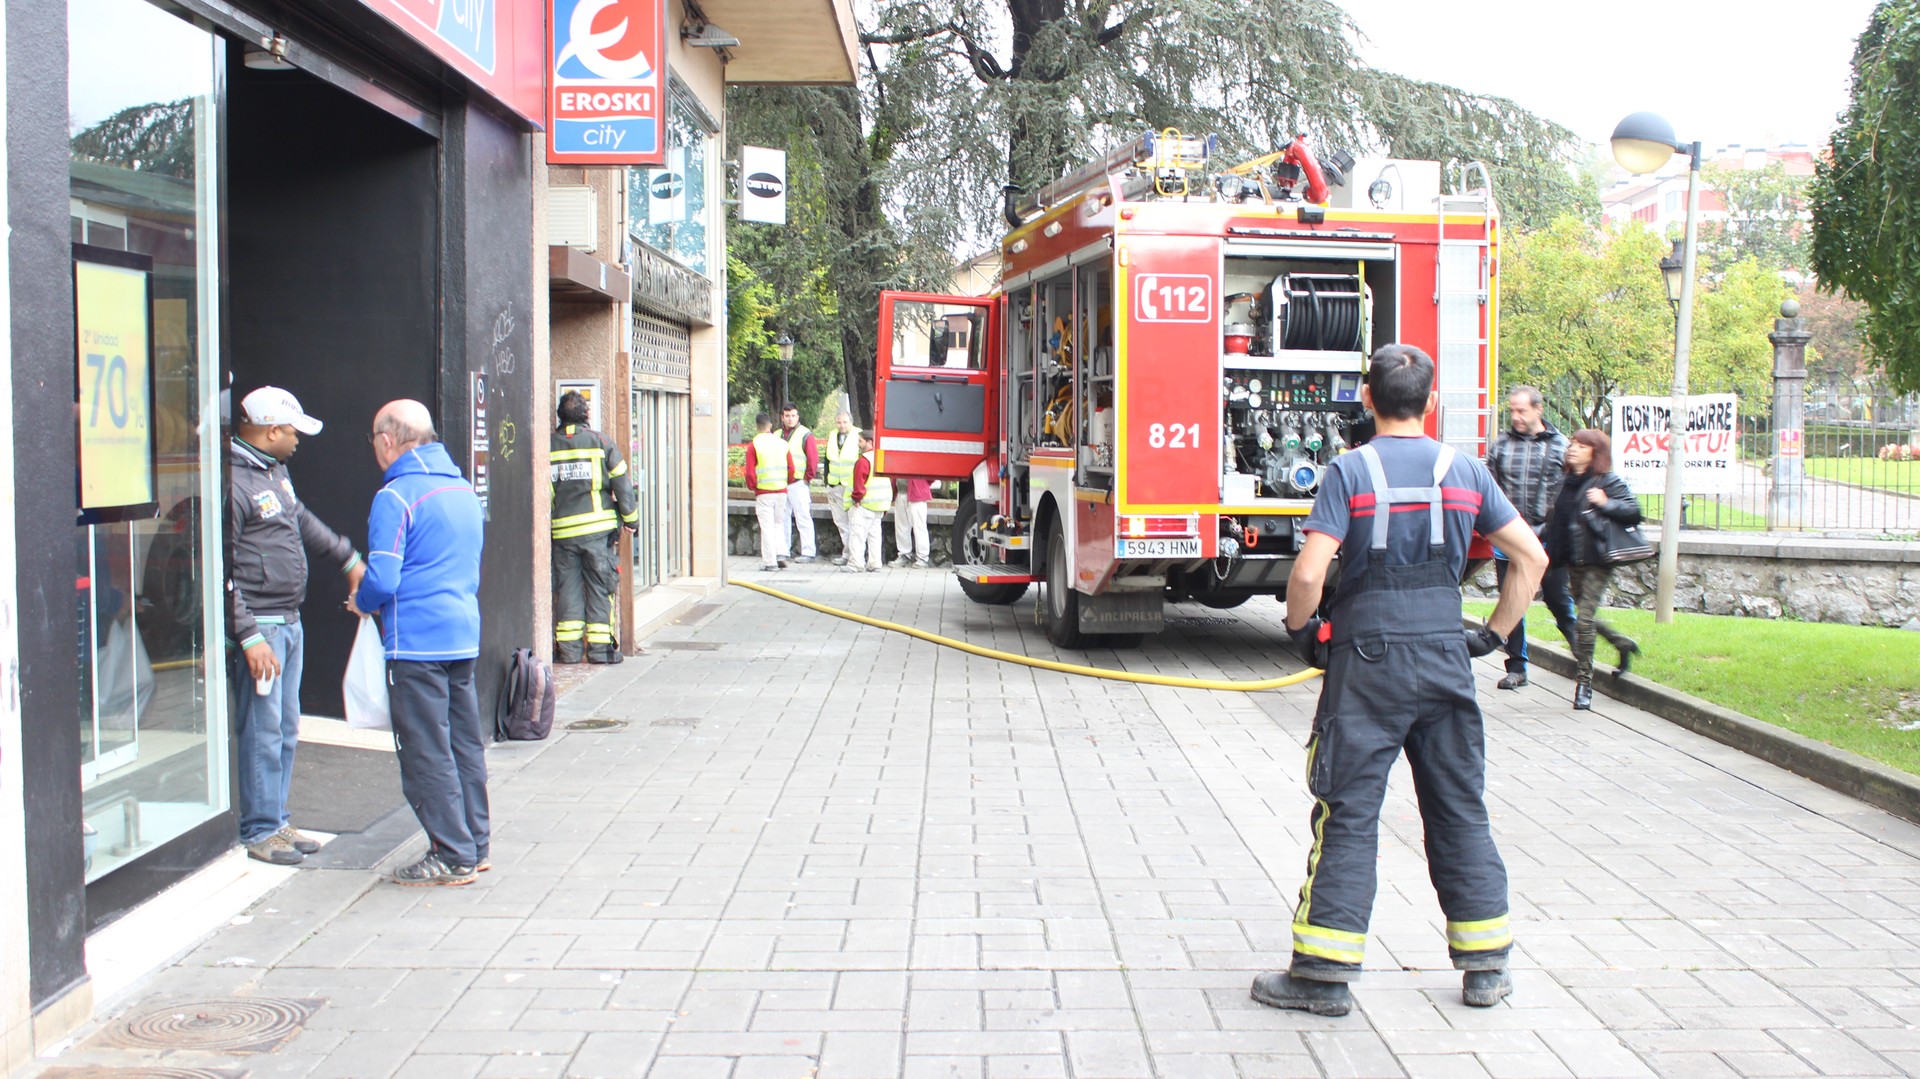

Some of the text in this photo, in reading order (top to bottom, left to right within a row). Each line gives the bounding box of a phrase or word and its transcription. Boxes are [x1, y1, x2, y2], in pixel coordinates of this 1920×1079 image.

[560, 92, 650, 112] EROSKI
[583, 124, 627, 150] city
[1159, 286, 1206, 312] 112
[1622, 403, 1732, 432] IBON IPAAGIRRE
[1148, 423, 1200, 449] 821
[1684, 460, 1712, 468] ORRIK
[1716, 460, 1727, 468] EZ
[1128, 541, 1198, 555] 5943 HNM
